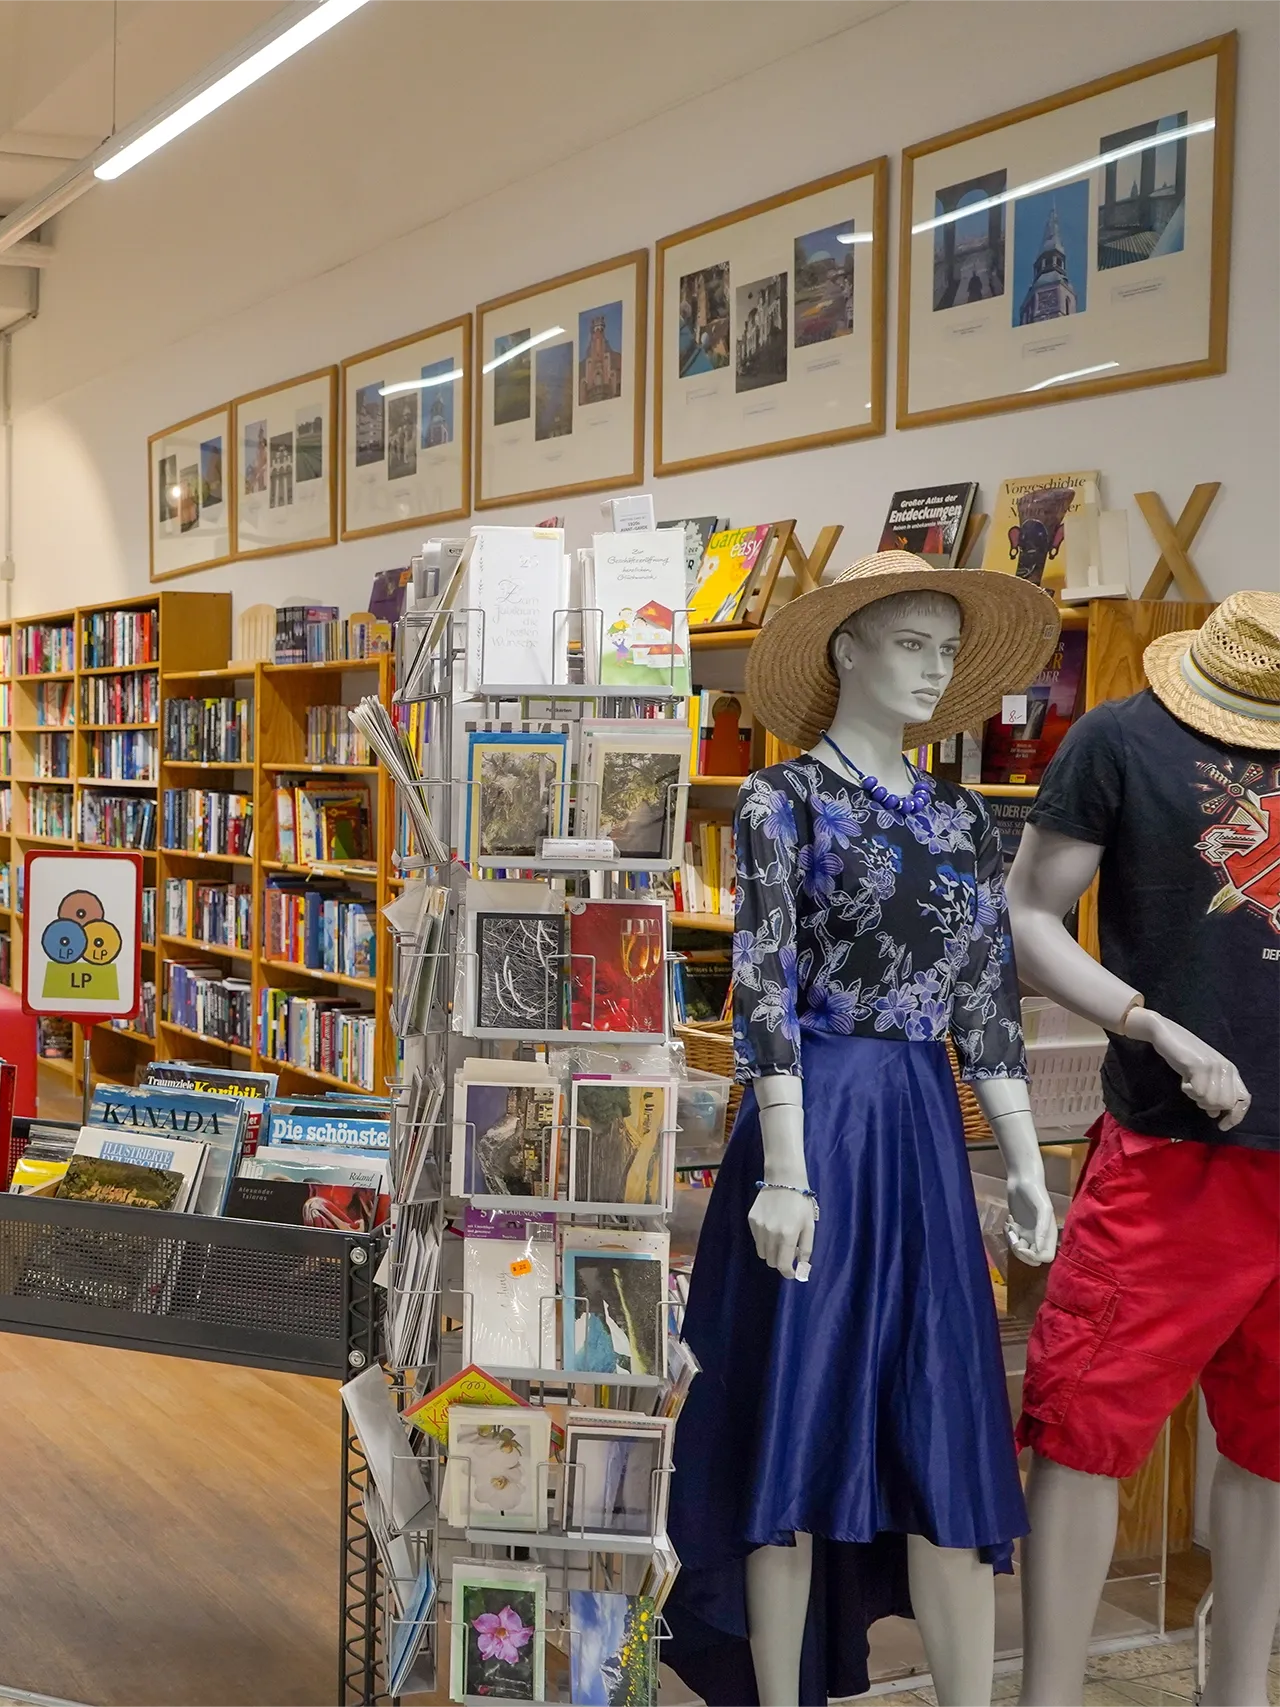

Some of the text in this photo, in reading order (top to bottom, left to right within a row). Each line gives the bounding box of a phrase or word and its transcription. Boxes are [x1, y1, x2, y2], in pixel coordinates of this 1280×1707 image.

[1005, 476, 1086, 495] Vorgeschichte
[901, 494, 958, 508] Großer Atlas der
[889, 504, 962, 524] Entdeckungen
[710, 529, 756, 549] Garte
[730, 539, 763, 560] easy
[496, 577, 539, 604] Zum
[59, 948, 74, 959] LP
[93, 949, 108, 960] LP
[71, 972, 92, 988] LP
[147, 1076, 195, 1090] Traumziele
[100, 1102, 222, 1135] KANADA
[273, 1119, 391, 1148] Die schönste
[103, 1141, 171, 1164] ILLUSTRIERTE
[349, 1172, 375, 1182] Roland
[238, 1186, 274, 1195] Alexander
